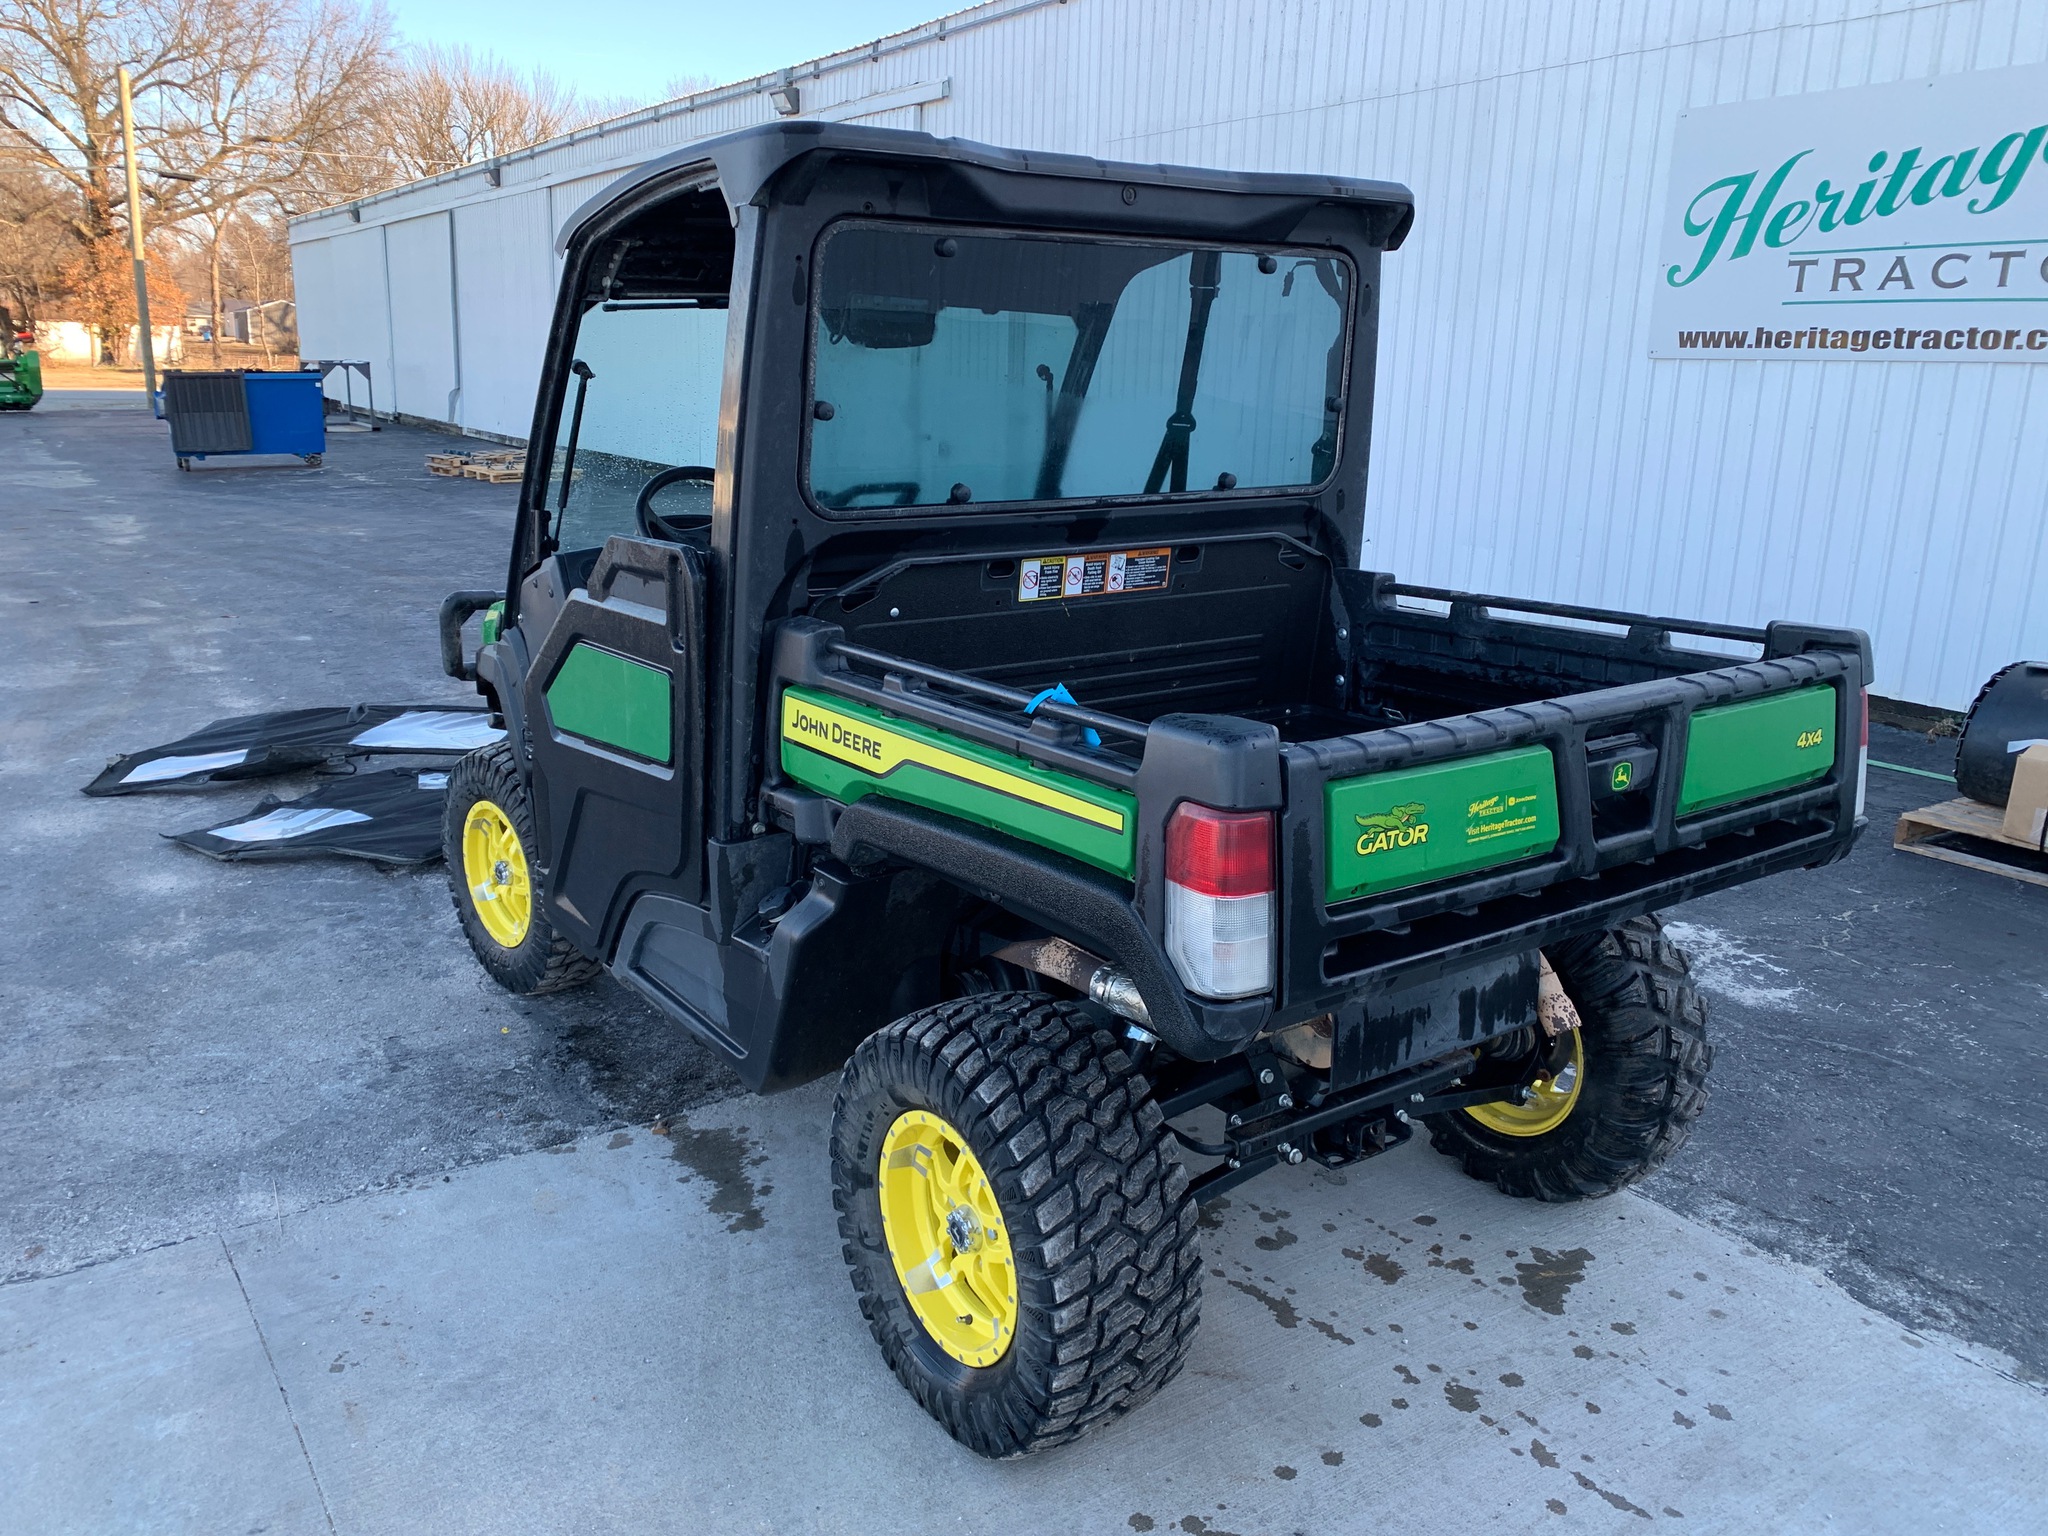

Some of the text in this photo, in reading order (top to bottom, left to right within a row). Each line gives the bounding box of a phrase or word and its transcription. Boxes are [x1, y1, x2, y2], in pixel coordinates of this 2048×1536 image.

[1666, 124, 2048, 288] Heritag
[1787, 249, 2048, 293] TRACT
[791, 709, 882, 760] JOHN DEERE
[1356, 824, 1429, 856] GATOR
